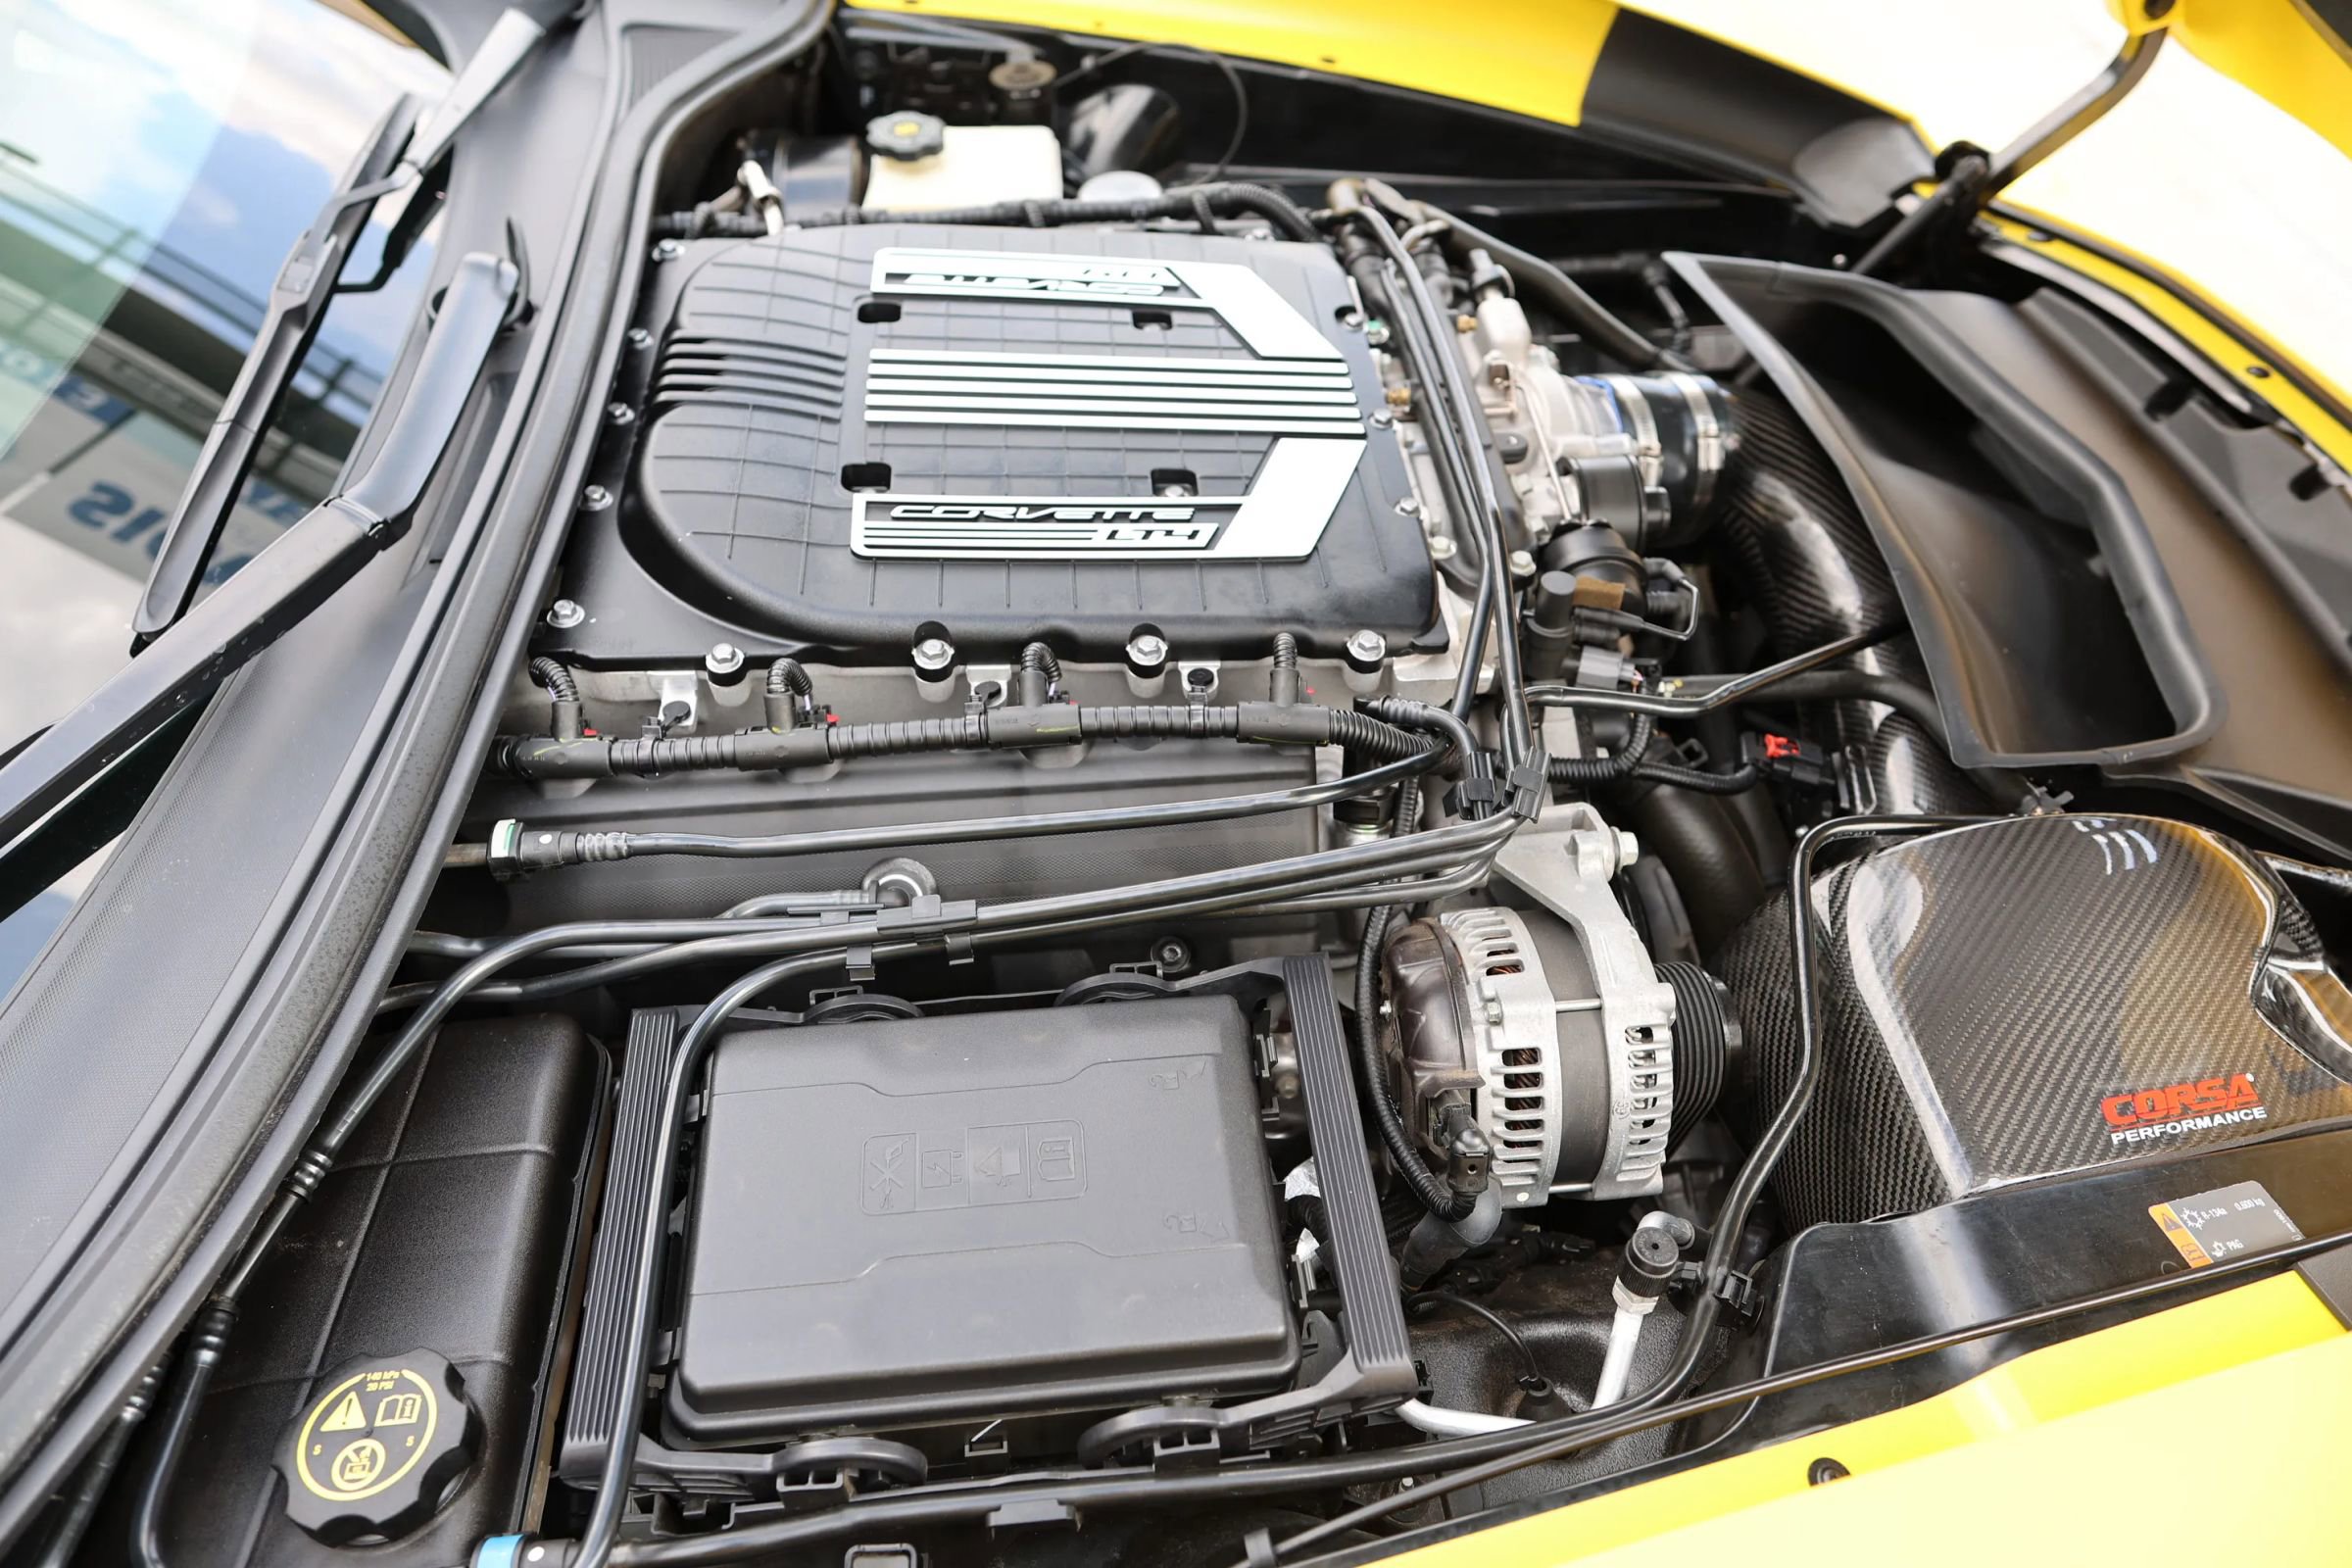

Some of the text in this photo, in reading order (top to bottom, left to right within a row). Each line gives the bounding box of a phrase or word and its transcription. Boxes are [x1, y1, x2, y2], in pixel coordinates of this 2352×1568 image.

[890, 505, 1196, 520] CORVETTE
[1105, 529, 1200, 541] LT4
[2101, 1073, 2259, 1125] CORSA
[2110, 1106, 2268, 1145] PERFORMANCE
